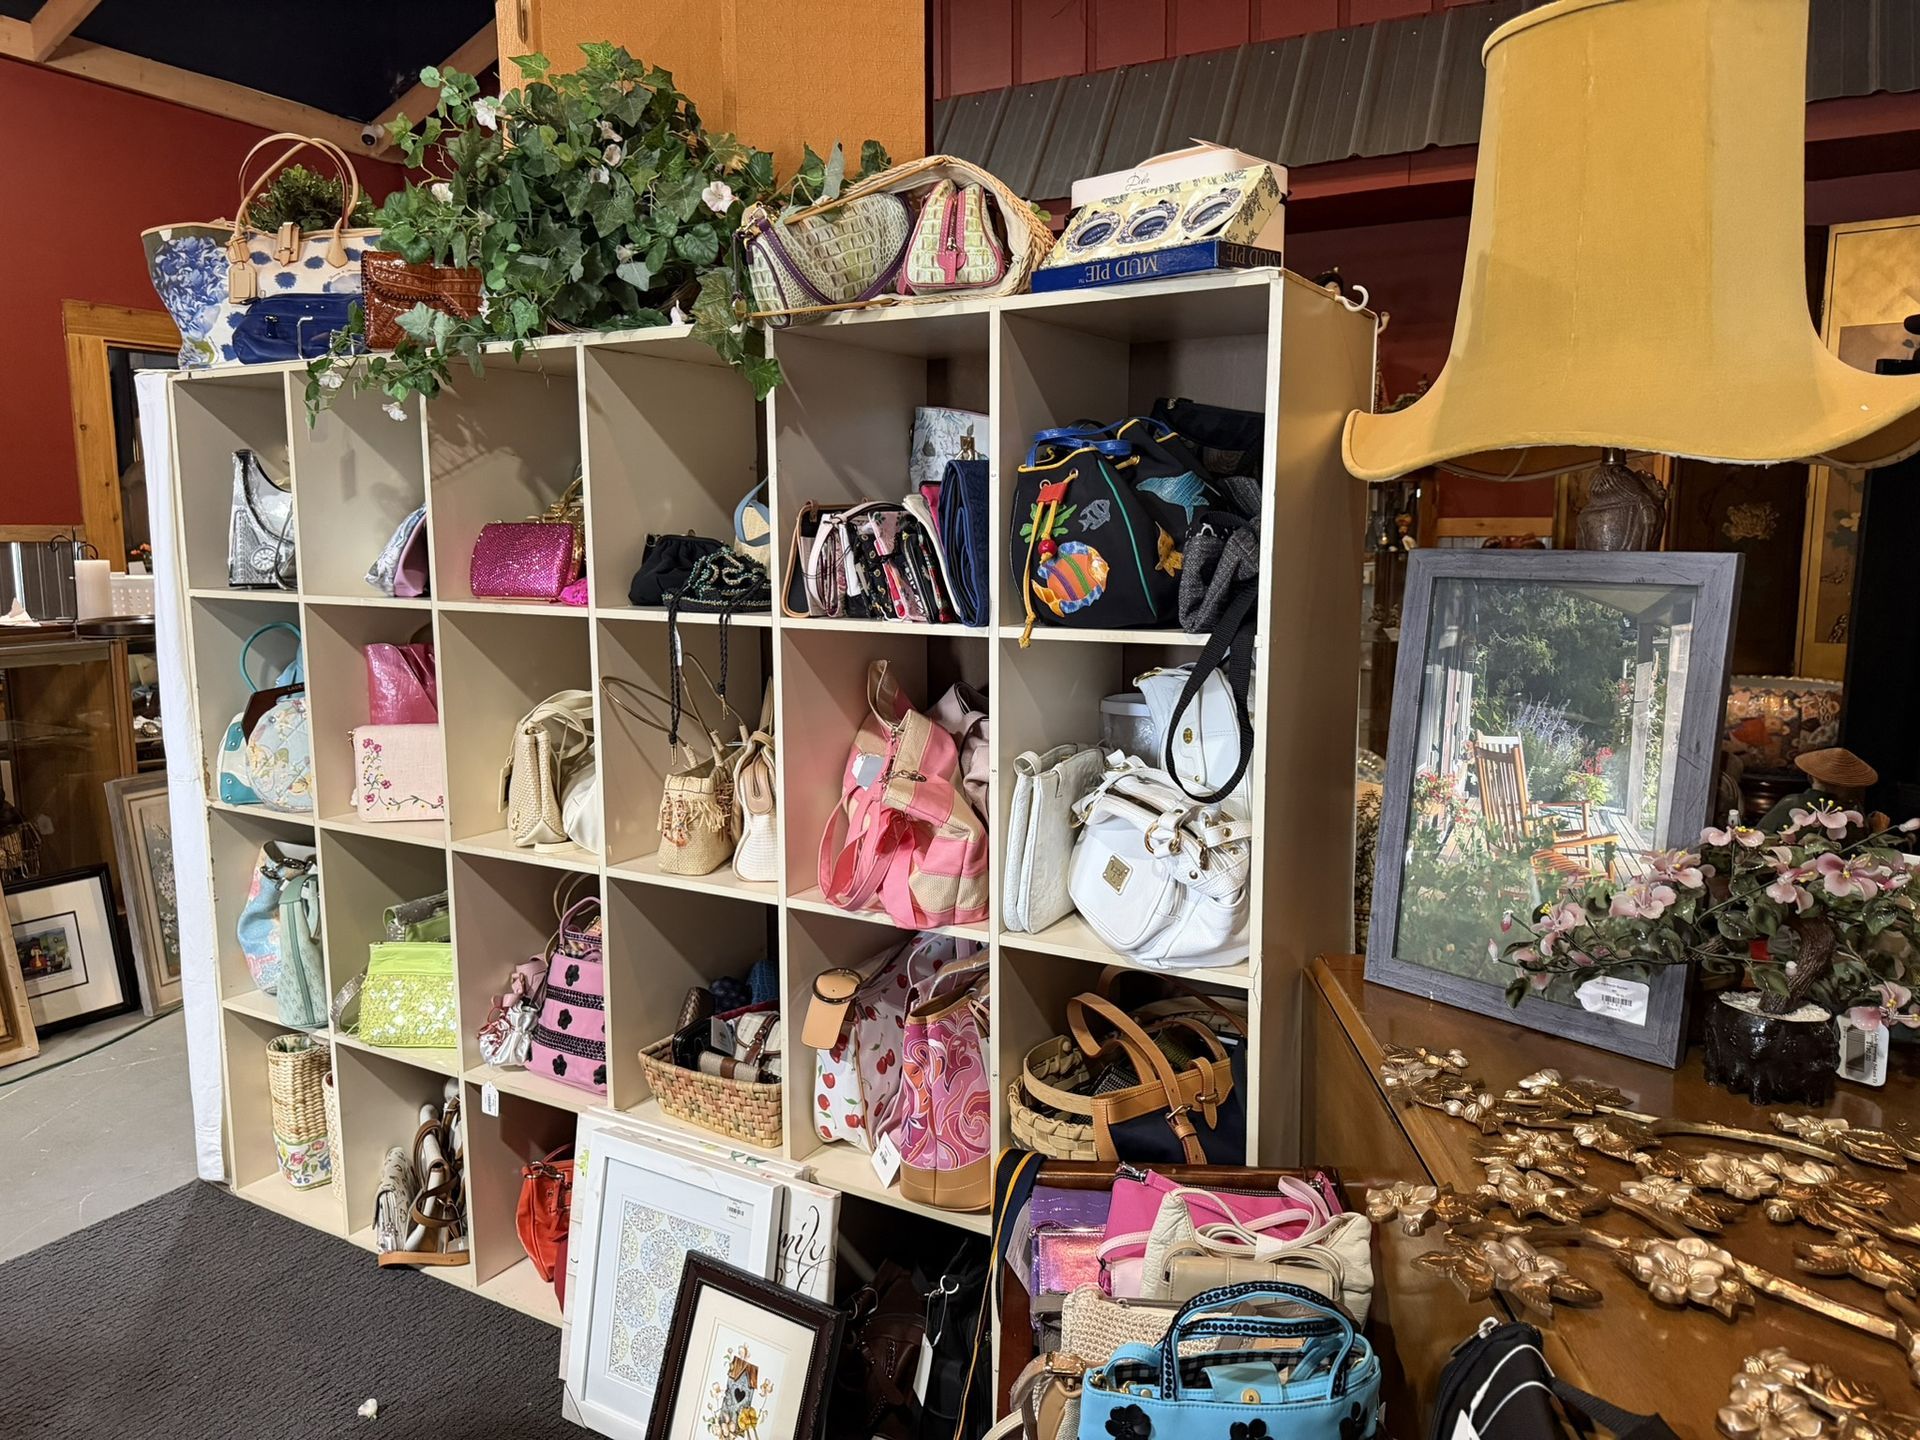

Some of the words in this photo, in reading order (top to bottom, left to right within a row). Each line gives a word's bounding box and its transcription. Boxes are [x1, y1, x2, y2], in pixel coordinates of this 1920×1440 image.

[1226, 244, 1246, 265] PIE
[1085, 262, 1110, 283] PIE
[1115, 254, 1159, 278] MUD
